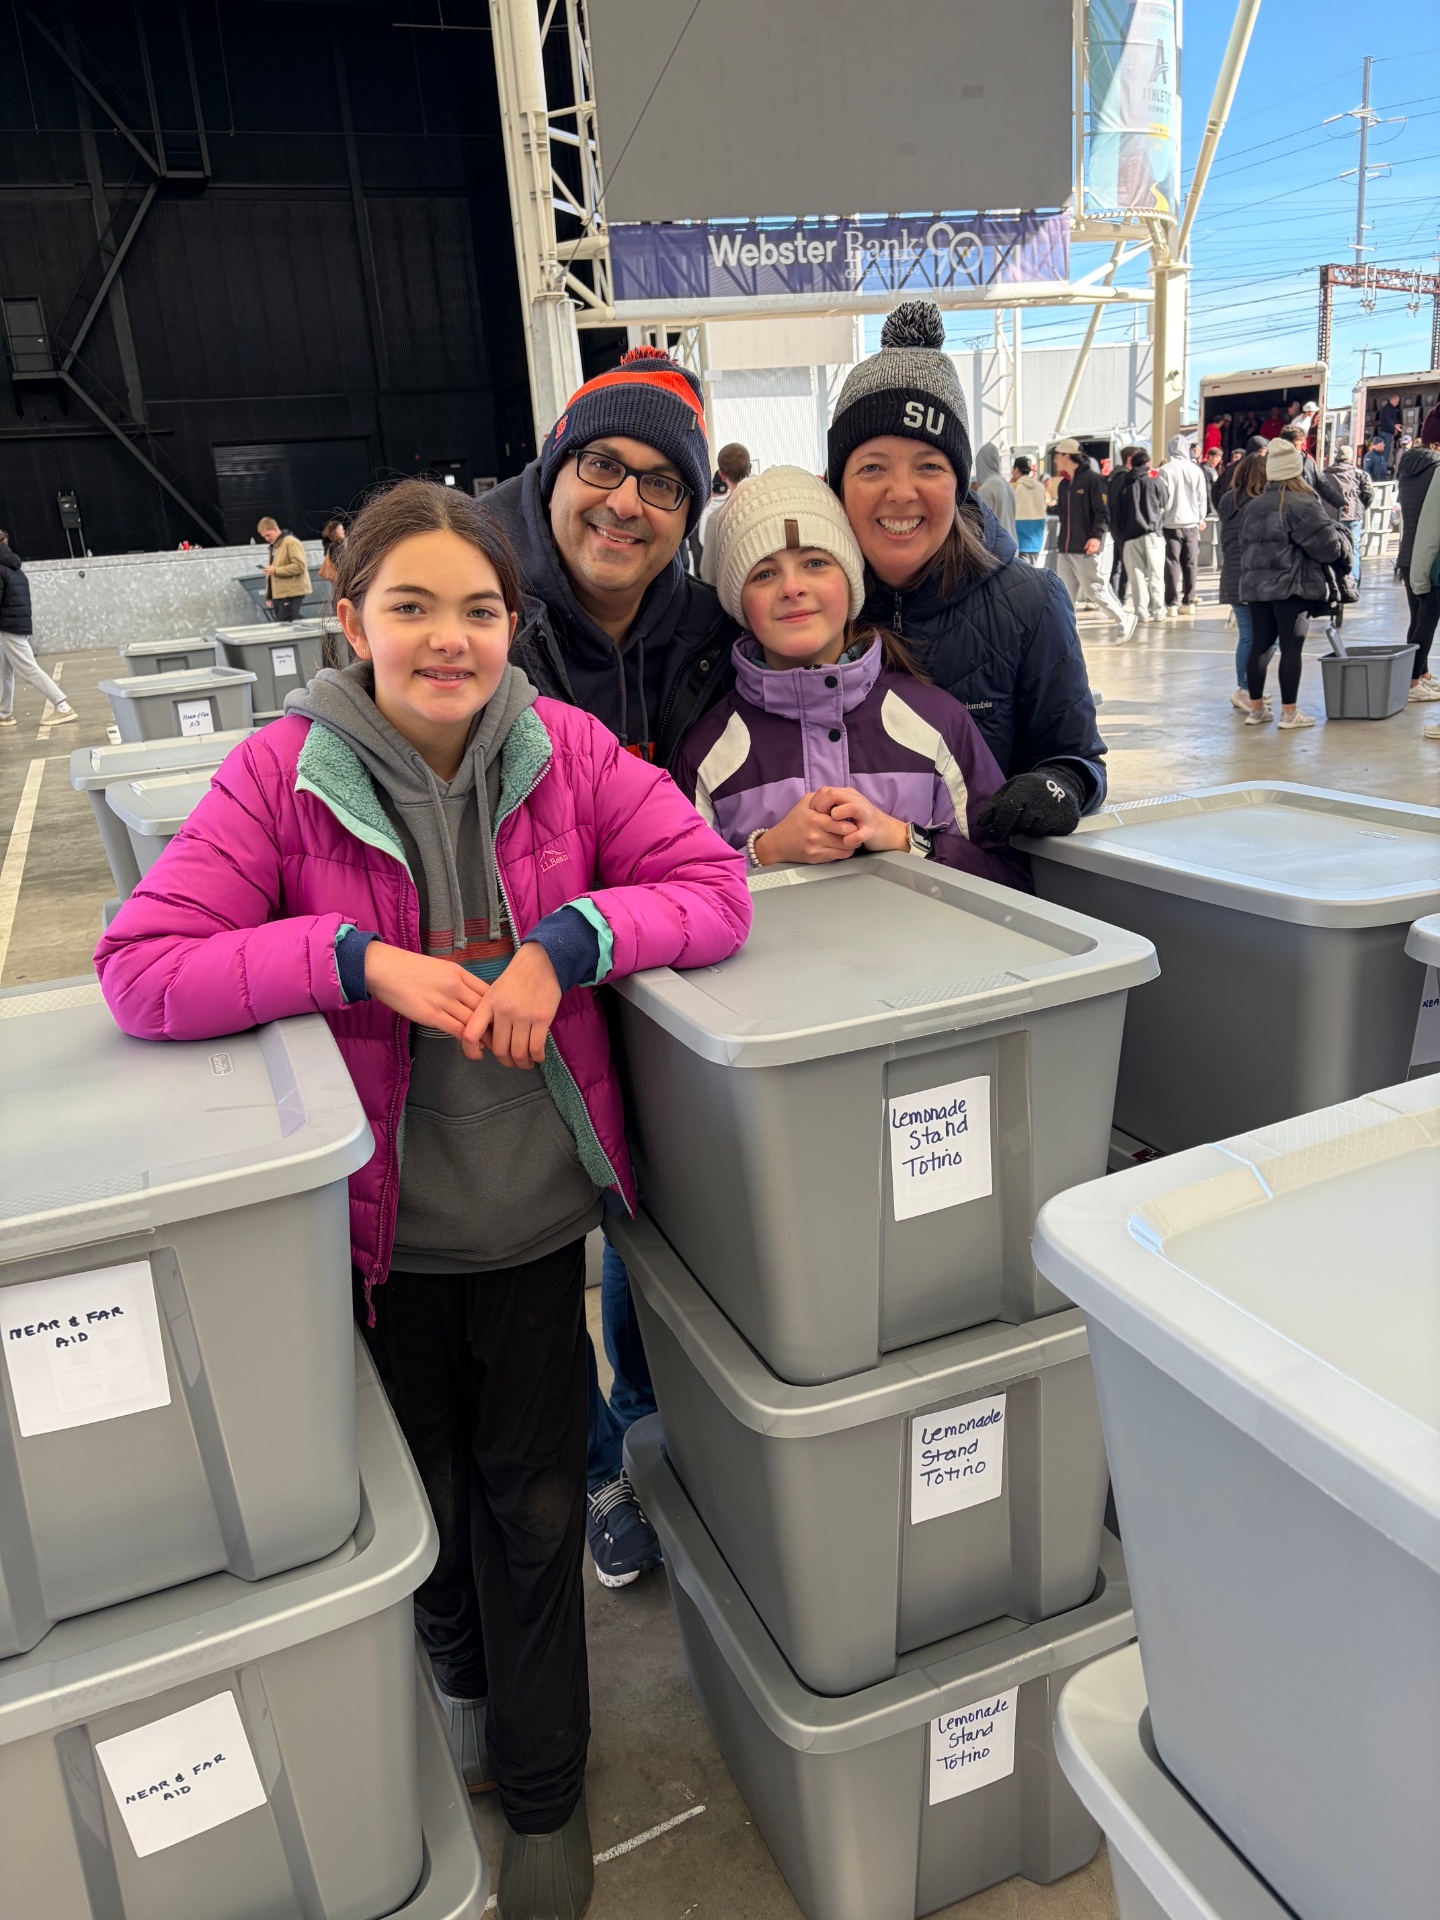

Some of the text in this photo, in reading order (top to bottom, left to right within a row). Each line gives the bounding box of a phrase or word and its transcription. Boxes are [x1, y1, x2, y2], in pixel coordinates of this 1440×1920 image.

[707, 232, 838, 269] Webster
[843, 229, 920, 263] Bank
[844, 266, 922, 280] CELEBRATING
[903, 400, 945, 436] SU
[963, 700, 993, 710] lumbia
[1046, 779, 1066, 802] OR
[1422, 998, 1440, 1008] NEA
[892, 1098, 967, 1128] Lemonade
[909, 1113, 969, 1150] Stand
[902, 1148, 963, 1177] Totino
[9, 1319, 61, 1340] NEAR
[86, 1306, 124, 1324] FAR
[55, 1332, 89, 1348] AID
[921, 1408, 1003, 1445] Lemonade
[921, 1437, 979, 1467] Stand
[920, 1458, 986, 1486] Totino
[938, 1699, 1009, 1734] Lemonade
[948, 1721, 994, 1748] Stand
[936, 1746, 990, 1770] Totino
[125, 1780, 170, 1804] NEAR
[192, 1753, 226, 1775] FAR
[163, 1785, 192, 1801] AID
